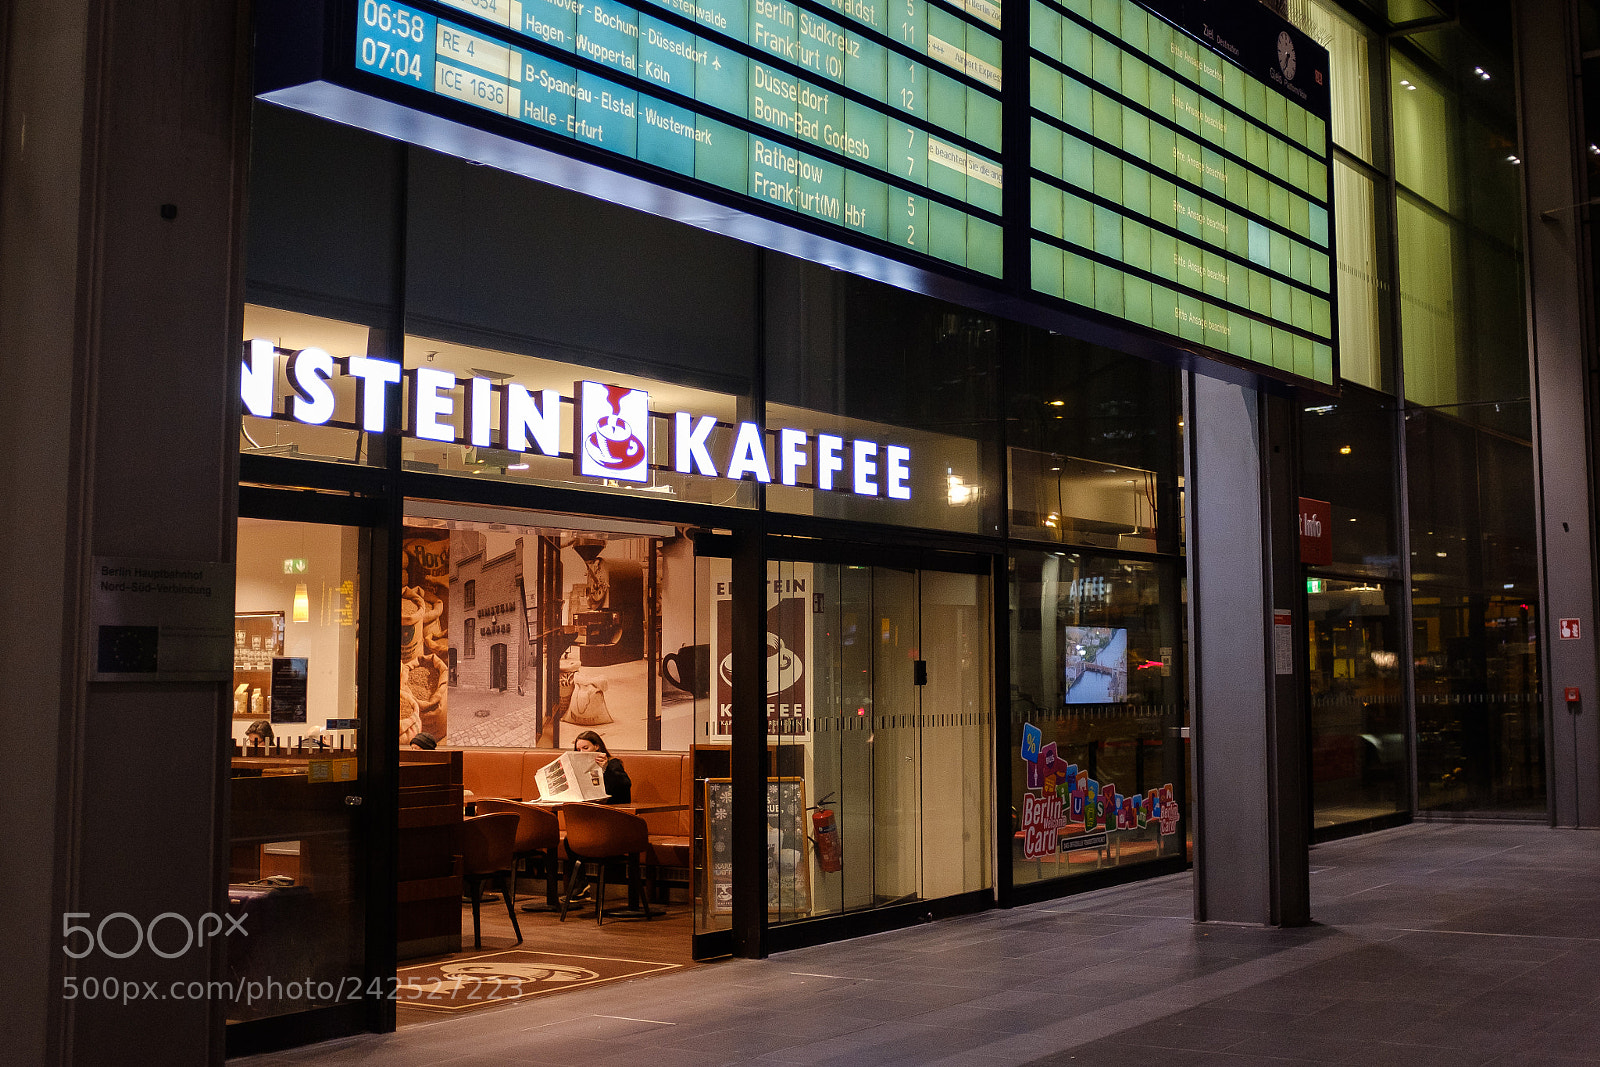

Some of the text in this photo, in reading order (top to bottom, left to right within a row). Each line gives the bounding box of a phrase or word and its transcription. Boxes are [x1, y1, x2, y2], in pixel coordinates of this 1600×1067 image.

[363, 0, 424, 42] 06:58
[667, 0, 727, 29] rstenwalde
[906, 0, 914, 17] 5
[442, 30, 475, 57] RE 4
[594, 6, 639, 38] Bochum
[648, 28, 707, 66] Düsseldorf
[755, 0, 860, 59] Berlin Südkreuz
[902, 22, 914, 45] 11
[362, 37, 423, 81] 07:04
[525, 13, 670, 84] Hagen Wuppertal Köln
[755, 22, 820, 70] Frankfurt
[440, 68, 505, 105] ICE 1636
[909, 64, 914, 83] 1
[525, 63, 713, 146] B-Spandau Elstal Wustermark
[755, 65, 829, 115] Düsseldorf
[900, 87, 914, 111] 12
[524, 99, 604, 142] Halle Erfurt
[754, 96, 870, 160] Bonn-Bad Godesb
[907, 129, 915, 149] 7
[755, 141, 823, 184] Rathenow
[907, 157, 915, 177] 7
[754, 171, 866, 229] Frankfurt(M) Hbf
[907, 196, 915, 217] 5
[907, 225, 915, 246] 2
[241, 340, 910, 500] NSTEIN KAFFEE
[1304, 513, 1321, 537] Info
[102, 566, 203, 581] Berlin Hauptbahnhof
[716, 579, 806, 596] EIEIN
[720, 704, 803, 717] KFEE
[1025, 795, 1061, 826] Berlin
[1027, 824, 1056, 854] Card
